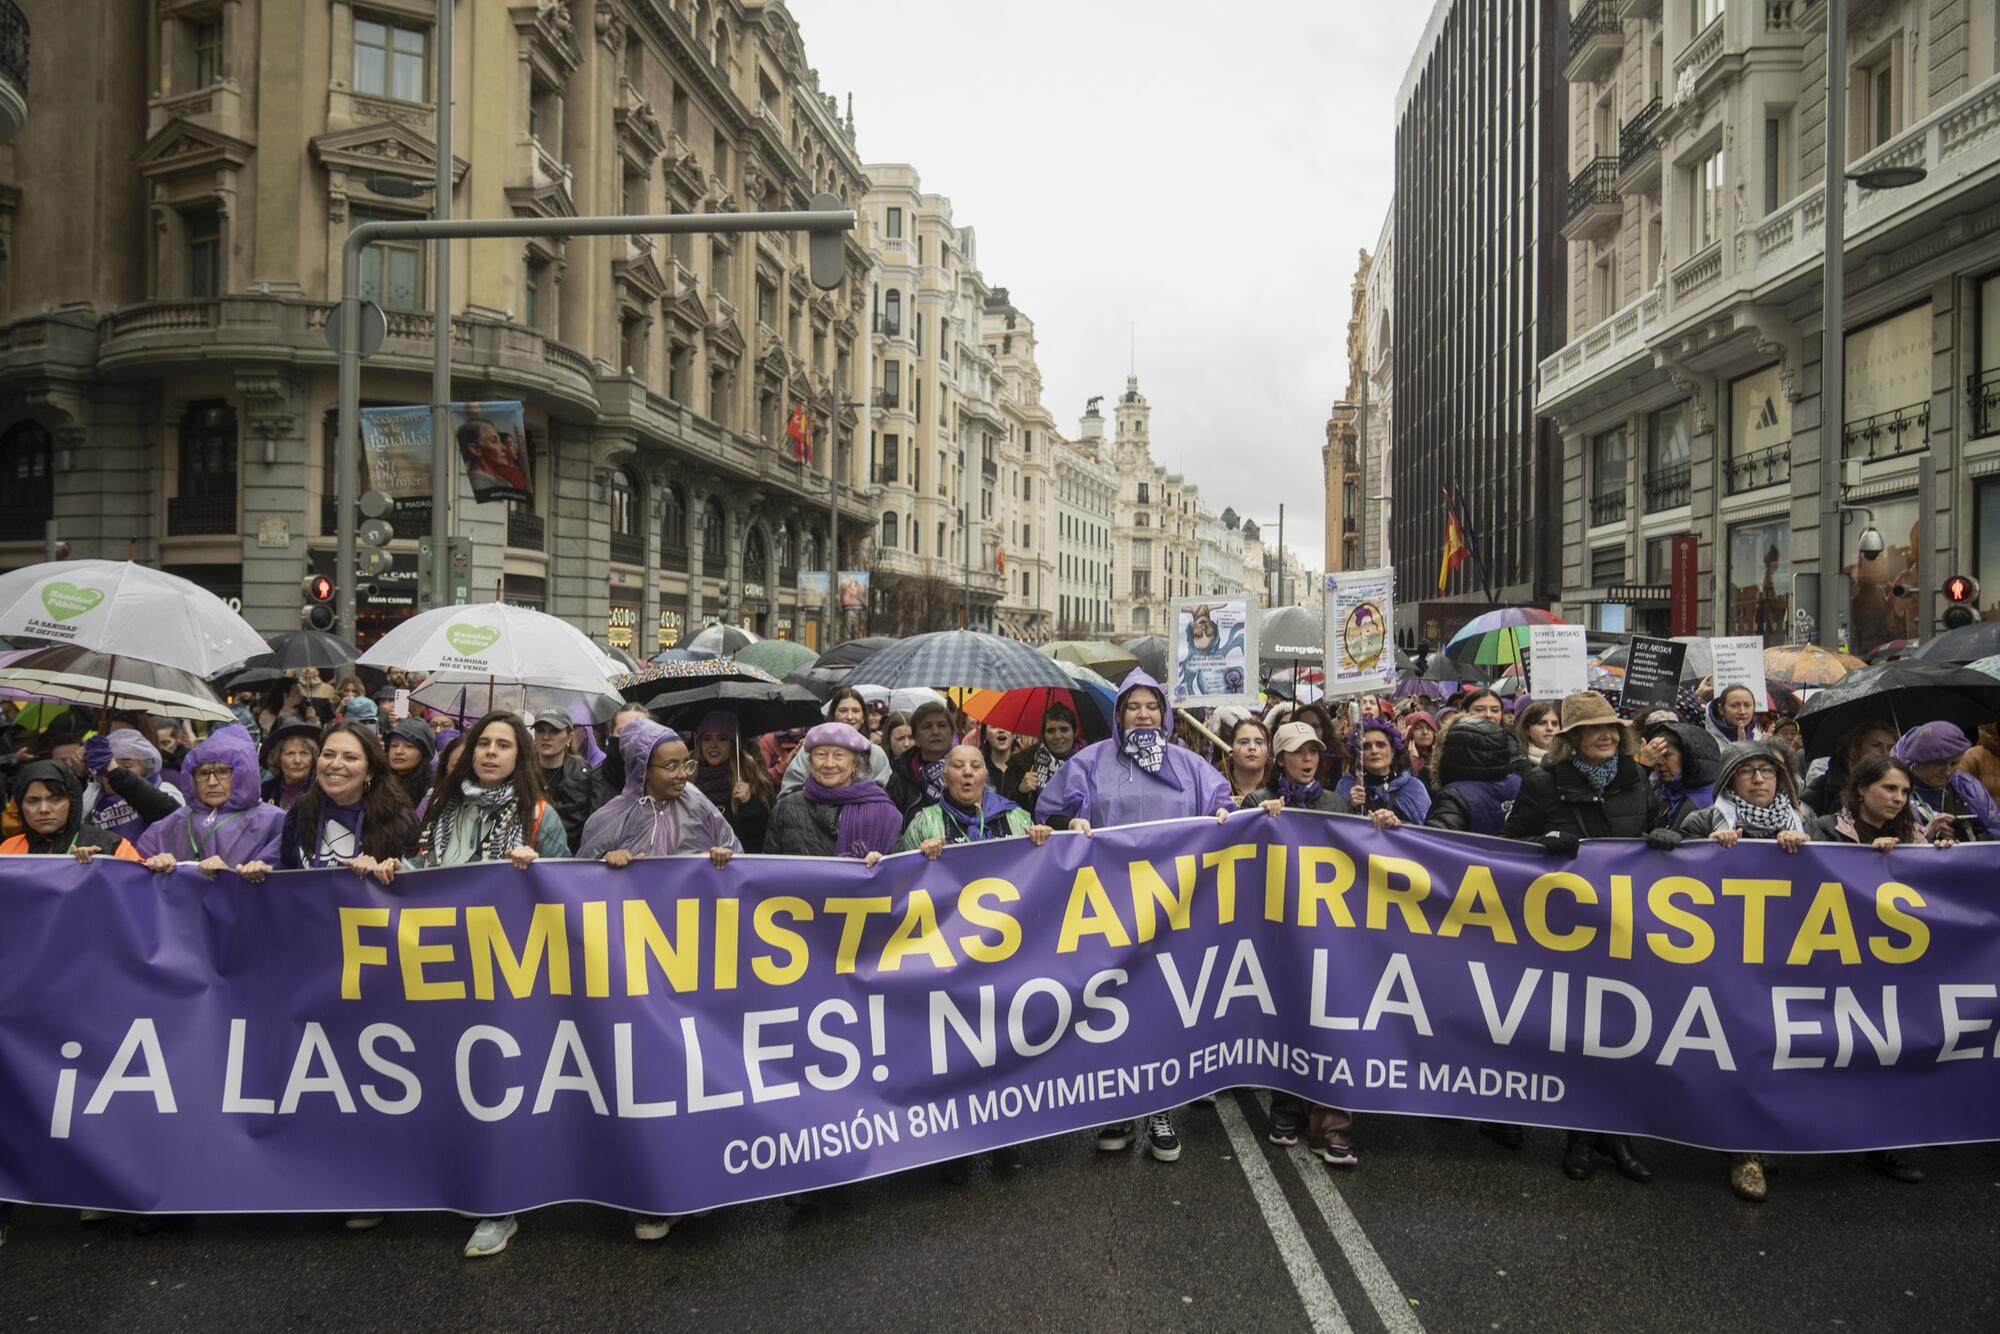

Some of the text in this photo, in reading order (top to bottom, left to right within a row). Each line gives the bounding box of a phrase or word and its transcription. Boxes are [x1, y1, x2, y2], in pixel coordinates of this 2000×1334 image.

[370, 431, 431, 452] igualdad
[49, 589, 94, 605] Sanidad
[24, 626, 77, 639] SE DEFIENDE
[40, 621, 77, 632] SANIDAD
[1636, 642, 1649, 650] SOY
[454, 657, 488, 665] SANIDAD
[1633, 658, 1658, 666] siembro
[463, 664, 488, 672] VENDE
[340, 844, 1931, 1000] FEMINISTAS ANTIRRACISTAS
[51, 939, 2000, 1138] ¡A LAS CALLES! NOS VA LA VIDA EN E
[724, 1038, 1566, 1174] COMISIÓN 8M MOVIMIENTO FEMINISTA DE MADRID
